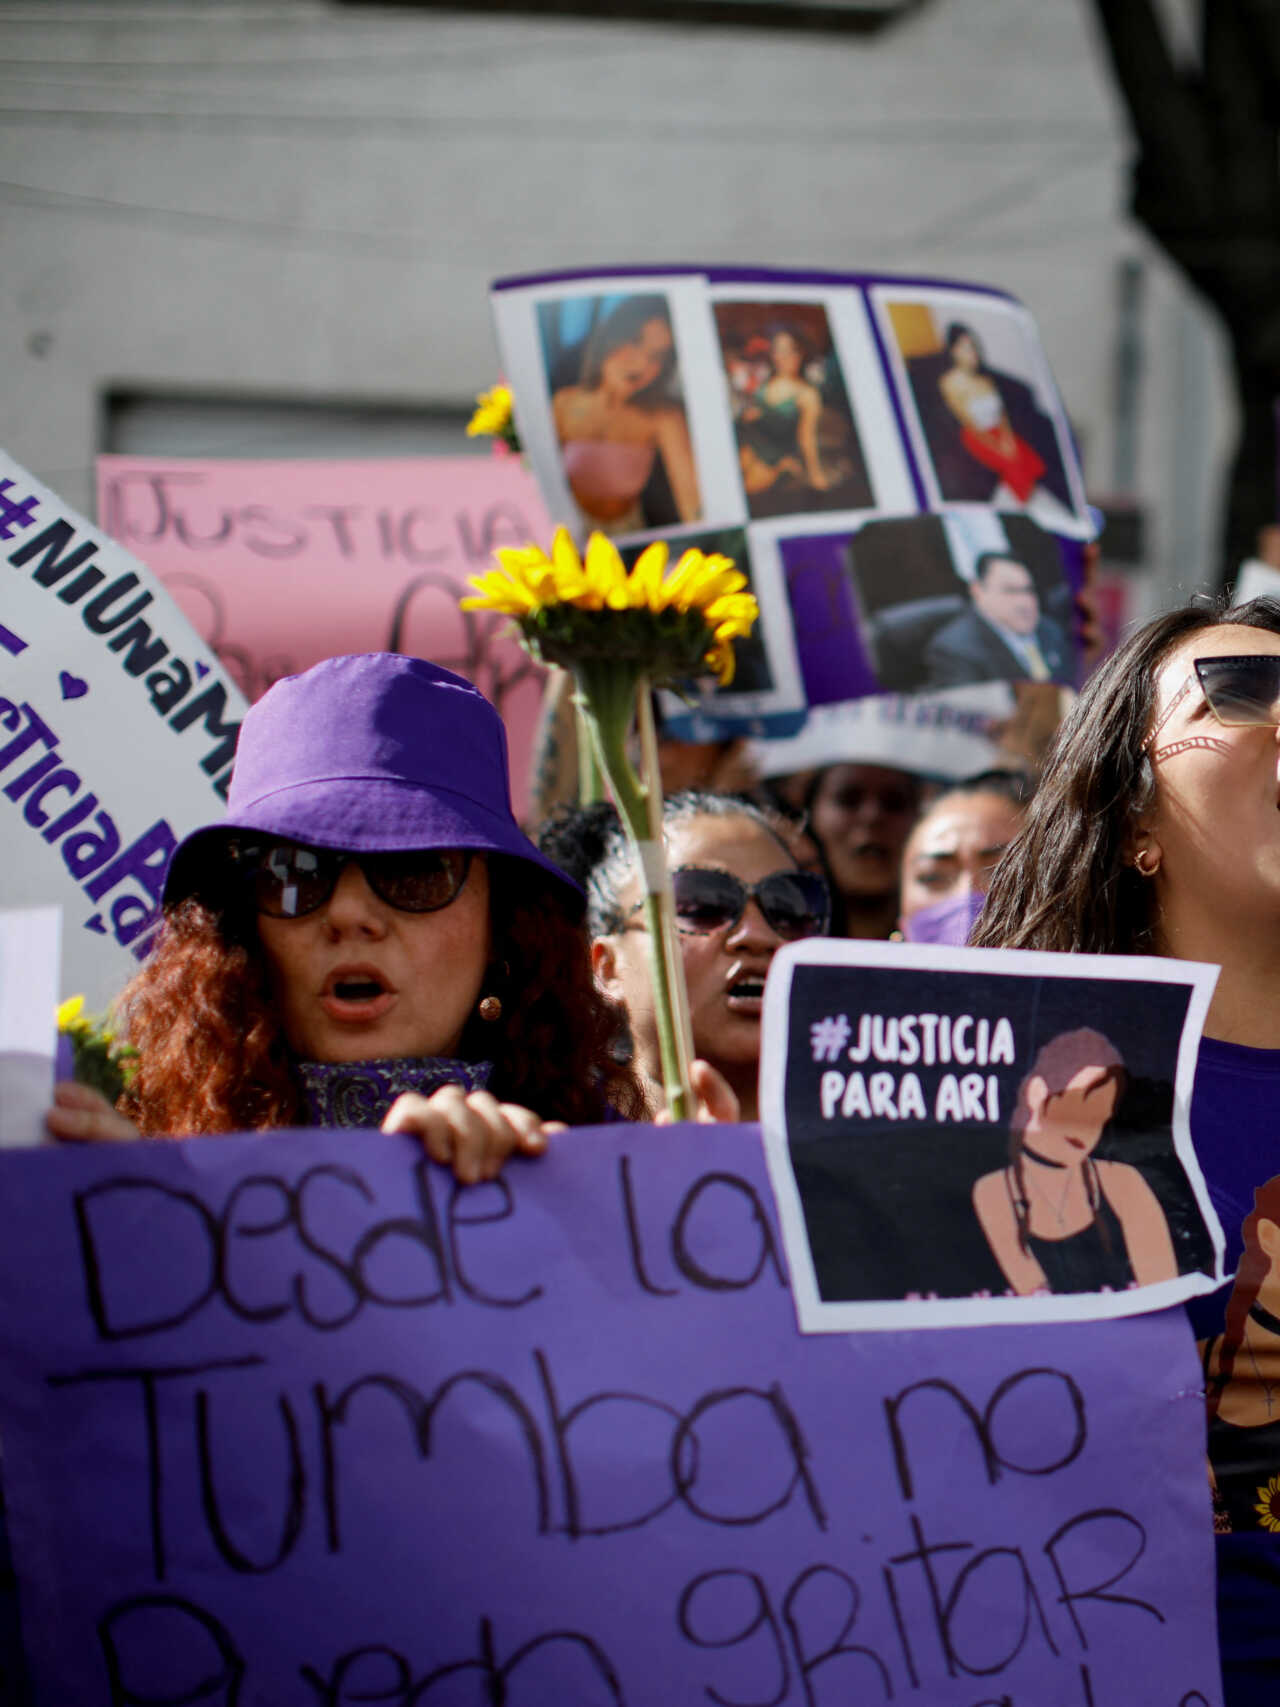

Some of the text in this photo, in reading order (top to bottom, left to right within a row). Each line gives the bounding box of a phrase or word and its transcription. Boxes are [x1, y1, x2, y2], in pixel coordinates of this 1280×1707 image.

[810, 1012, 1015, 1066] #JUSTICIA
[820, 1072, 1002, 1124] PARA ARI
[72, 1153, 790, 1344] Desde la
[44, 1346, 1090, 1584] Tumba no
